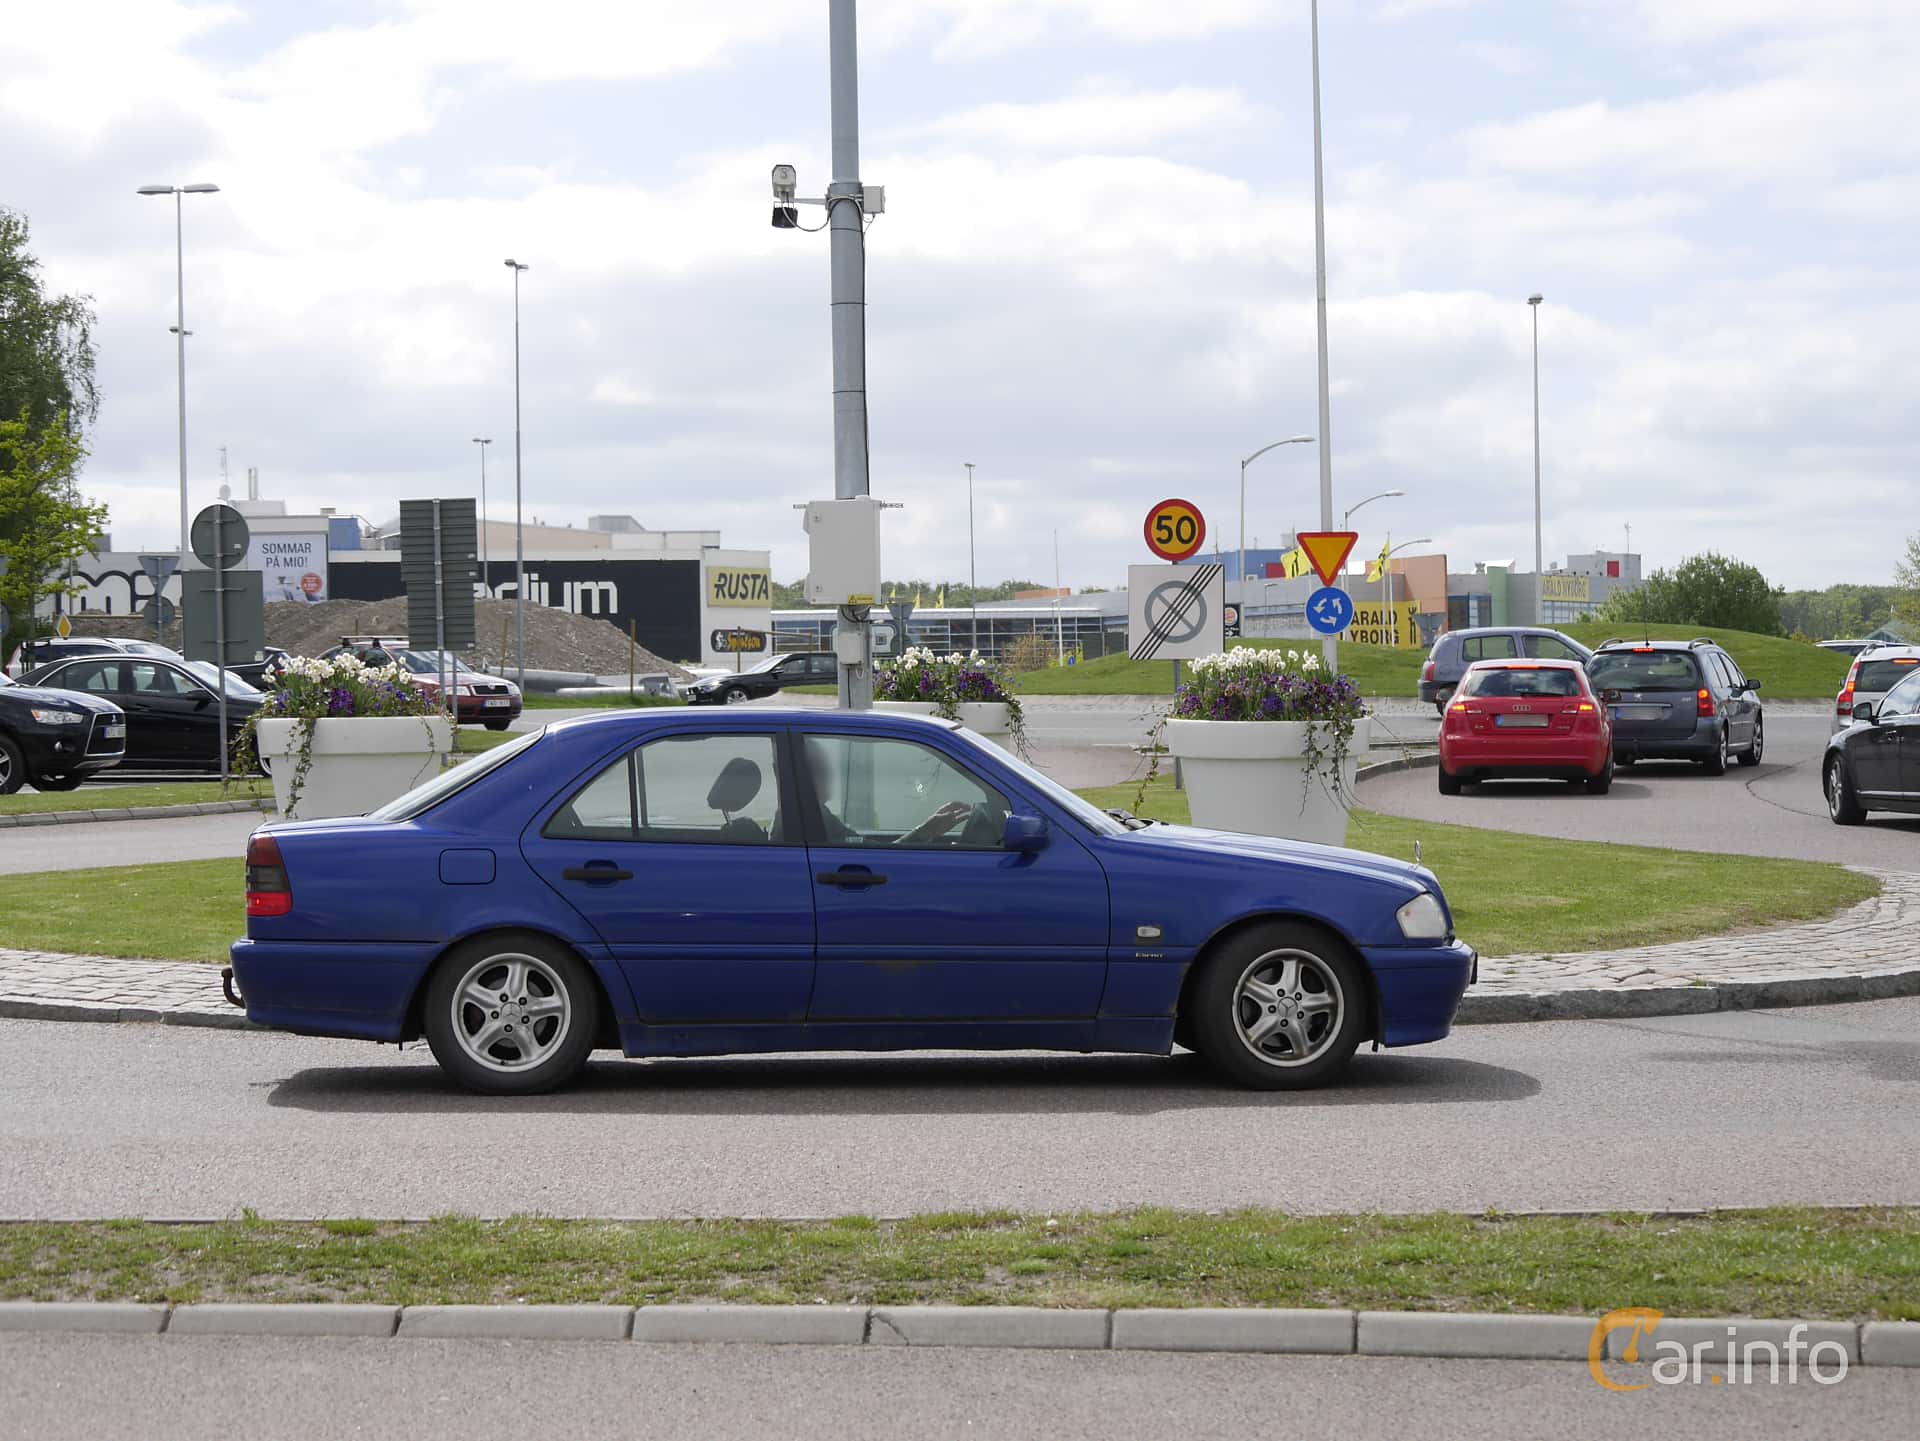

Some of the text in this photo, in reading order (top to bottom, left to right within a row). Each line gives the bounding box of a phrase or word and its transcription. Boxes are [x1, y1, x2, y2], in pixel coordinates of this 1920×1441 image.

[1156, 514, 1197, 545] 50
[262, 543, 312, 554] SOMMAR
[266, 555, 308, 568] PÅ MIO!
[714, 572, 769, 600] RUSTA
[1350, 610, 1398, 626] ARALD
